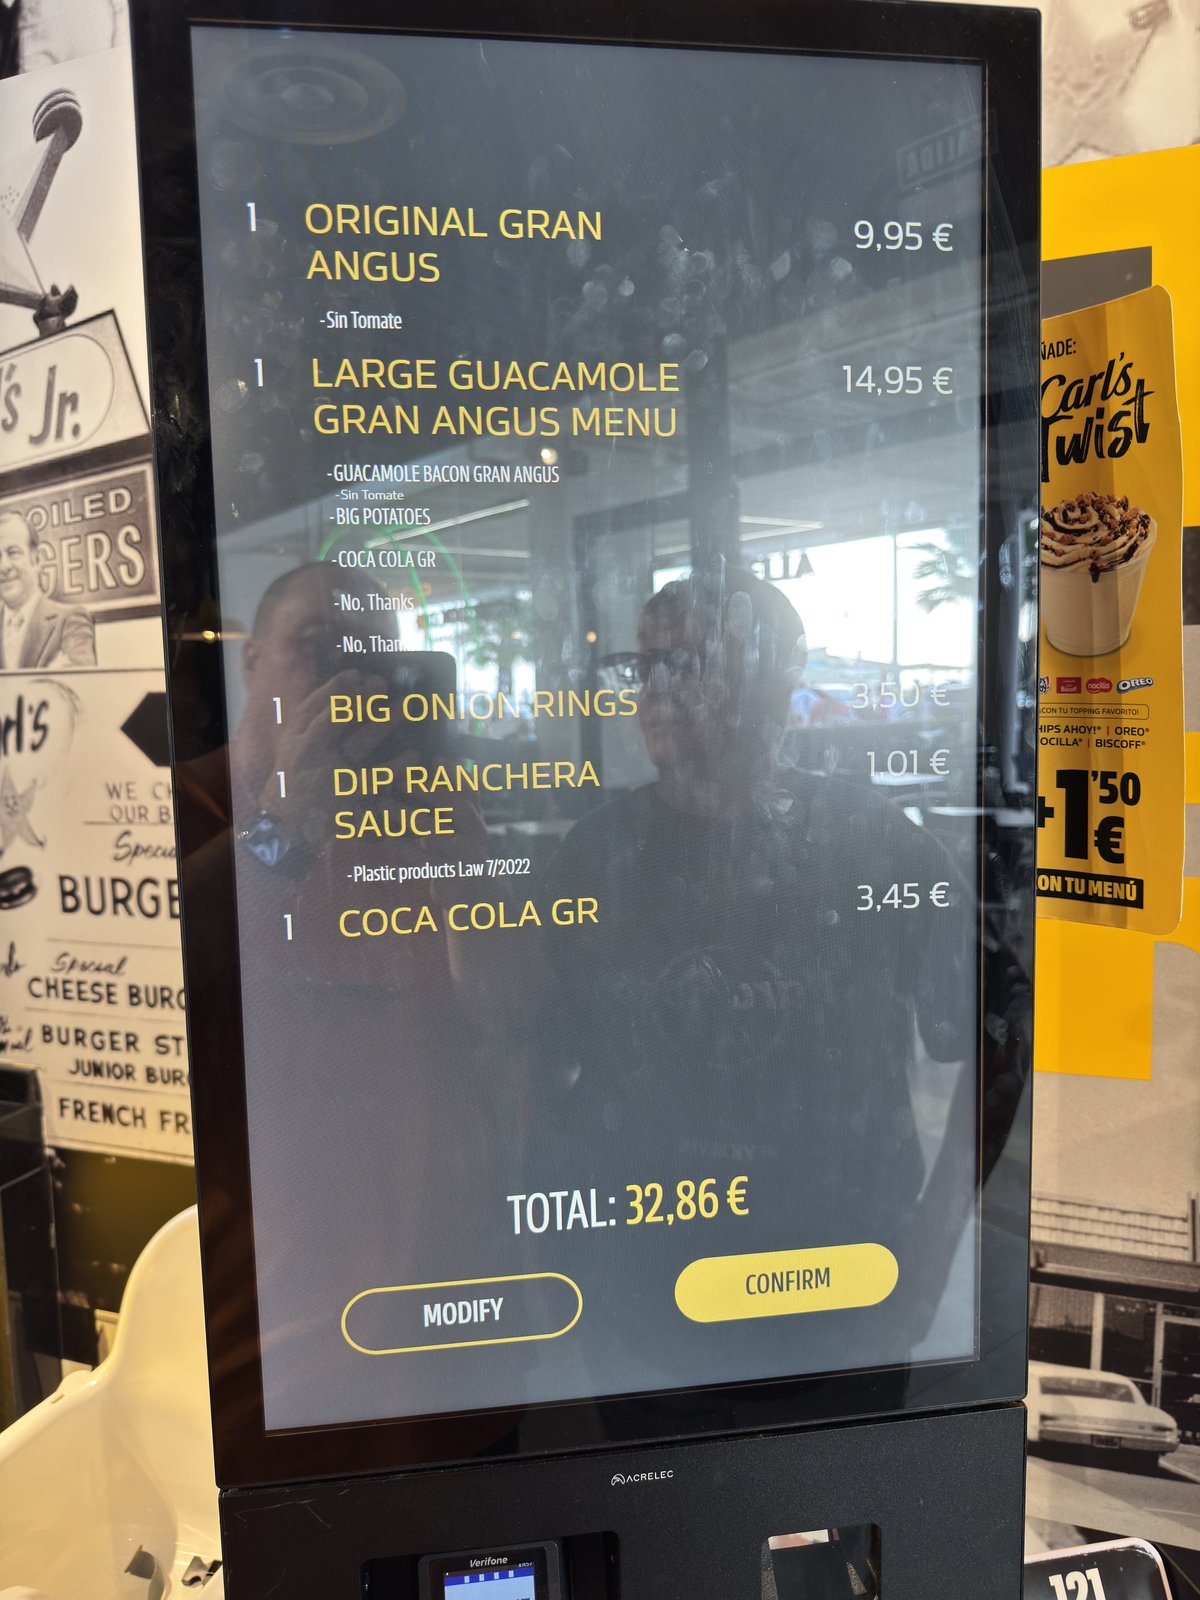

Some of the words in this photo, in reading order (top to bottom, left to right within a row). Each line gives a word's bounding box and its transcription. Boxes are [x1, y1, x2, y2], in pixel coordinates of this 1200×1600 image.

[246, 202, 257, 232] 1
[304, 202, 488, 238] ORIGINAL
[499, 208, 602, 241] GRAN
[853, 220, 923, 251] 9,95
[932, 223, 953, 251] €
[306, 250, 441, 283] ANGUS
[352, 312, 402, 330] Tomate
[253, 358, 264, 387] 1
[311, 358, 437, 389] LARGE
[448, 360, 679, 393] GUACAMOLE
[842, 365, 923, 396] 14,95
[932, 367, 953, 395] €
[28, 365, 81, 445] Jr.
[313, 404, 420, 435] GRAN
[431, 405, 560, 436] ANGUS
[572, 406, 677, 438] MENU
[1041, 379, 1155, 483] Twist
[424, 465, 470, 483] BACON
[473, 465, 511, 483] GRAN
[513, 465, 559, 483] ANGUS
[361, 489, 405, 501] Tomate
[363, 507, 431, 525] POTATOES
[378, 551, 414, 568] COLA
[417, 551, 436, 568] GR
[367, 594, 415, 611] Thanks
[369, 635, 406, 653] Than
[852, 680, 920, 710] 3,50
[930, 682, 950, 706] €
[1118, 677, 1154, 691] OREO
[272, 697, 282, 723] 1
[330, 695, 391, 723] BIG
[402, 692, 521, 722] ONION
[534, 689, 637, 718] RINGS
[1102, 708, 1139, 716] FAVORITO!
[929, 749, 950, 775] €
[106, 782, 137, 800] WE
[276, 771, 286, 798] 1
[334, 768, 394, 797] DIP
[406, 761, 600, 794] RANCHERA
[110, 805, 148, 824] OUR
[335, 808, 455, 840] SAUCE
[1094, 816, 1125, 864] €
[399, 861, 455, 883] products
[459, 860, 484, 878] Law
[486, 858, 530, 878] 7/2022
[857, 882, 920, 912] 3,45
[929, 882, 949, 907] €
[1064, 876, 1085, 894] TU
[1088, 880, 1137, 901] MENÚ
[284, 914, 293, 940] 1
[339, 906, 438, 938] COCA
[448, 900, 541, 933] COLA
[552, 897, 599, 926] GR
[28, 977, 118, 1005] CHEESE
[41, 1024, 140, 1053] BURGER
[69, 1058, 136, 1081] JUNIOR
[146, 1066, 190, 1086] BUR
[58, 1097, 146, 1128] FRENCH
[507, 1188, 617, 1235] TOTAL:
[625, 1178, 719, 1227] 32,86
[727, 1176, 749, 1215] €
[745, 1267, 831, 1296] CONFIRM
[423, 1298, 504, 1328] MODIFY
[625, 1469, 674, 1483] ACRELEC
[469, 1555, 508, 1568] Verifone
